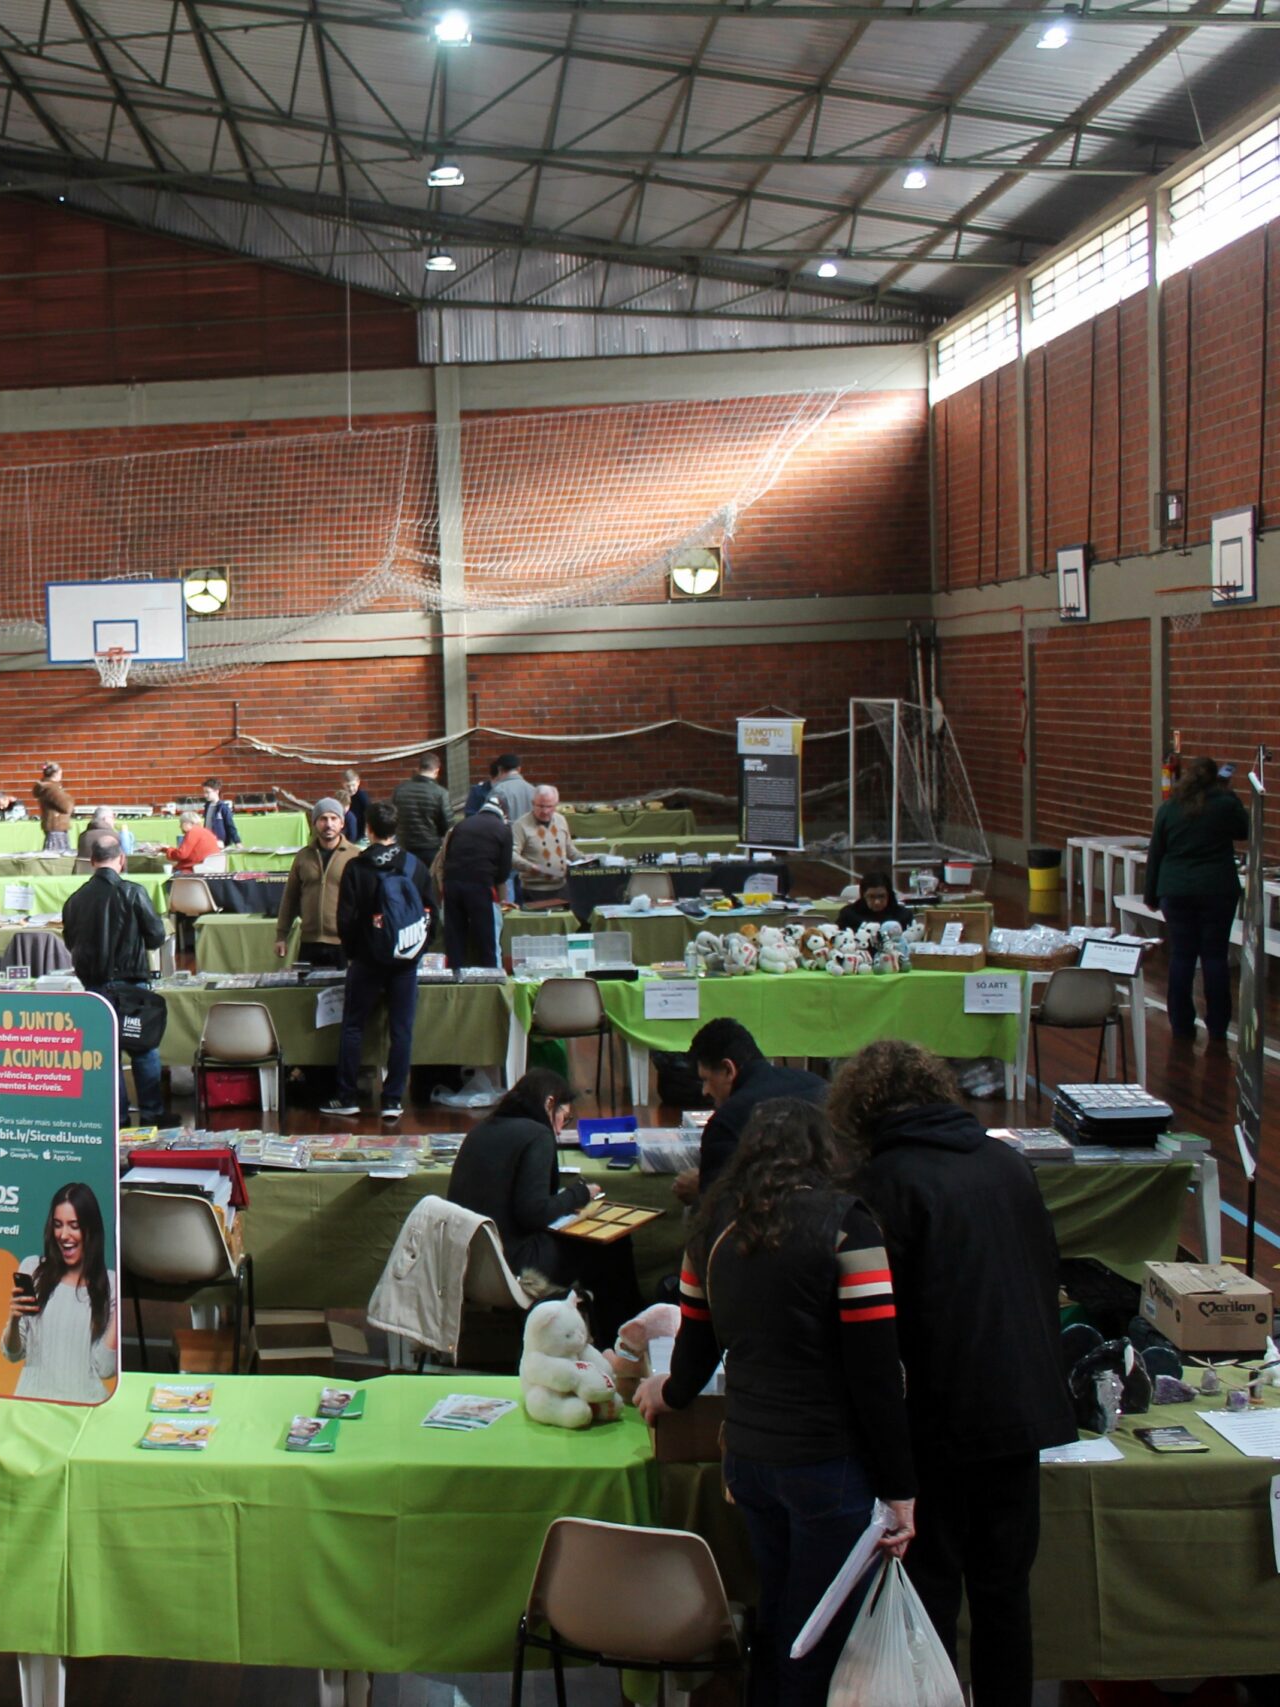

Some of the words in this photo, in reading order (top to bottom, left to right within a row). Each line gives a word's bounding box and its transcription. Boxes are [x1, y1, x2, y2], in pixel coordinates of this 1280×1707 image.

[744, 728, 784, 738] ZANOTTO
[976, 981, 987, 989] SÓ
[3, 1010, 13, 1030] O
[20, 1011, 77, 1033] JUNTOS,
[20, 1034, 32, 1042] vai
[33, 1036, 60, 1044] querer
[61, 1036, 75, 1044] ser
[3, 1048, 103, 1071] ACUMULADOR
[35, 1073, 71, 1082] produtos
[28, 1083, 63, 1092] incríveis.
[0, 1116, 14, 1124] Para
[16, 1117, 33, 1125] saber
[35, 1119, 51, 1127] mais
[53, 1120, 71, 1128] sobre
[78, 1121, 102, 1129] Juntos:
[0, 1128, 102, 1145] bit.ly/SicrediJuntos
[53, 1154, 65, 1162] App
[66, 1154, 82, 1162] Store
[1198, 1301, 1255, 1318] Marilan
